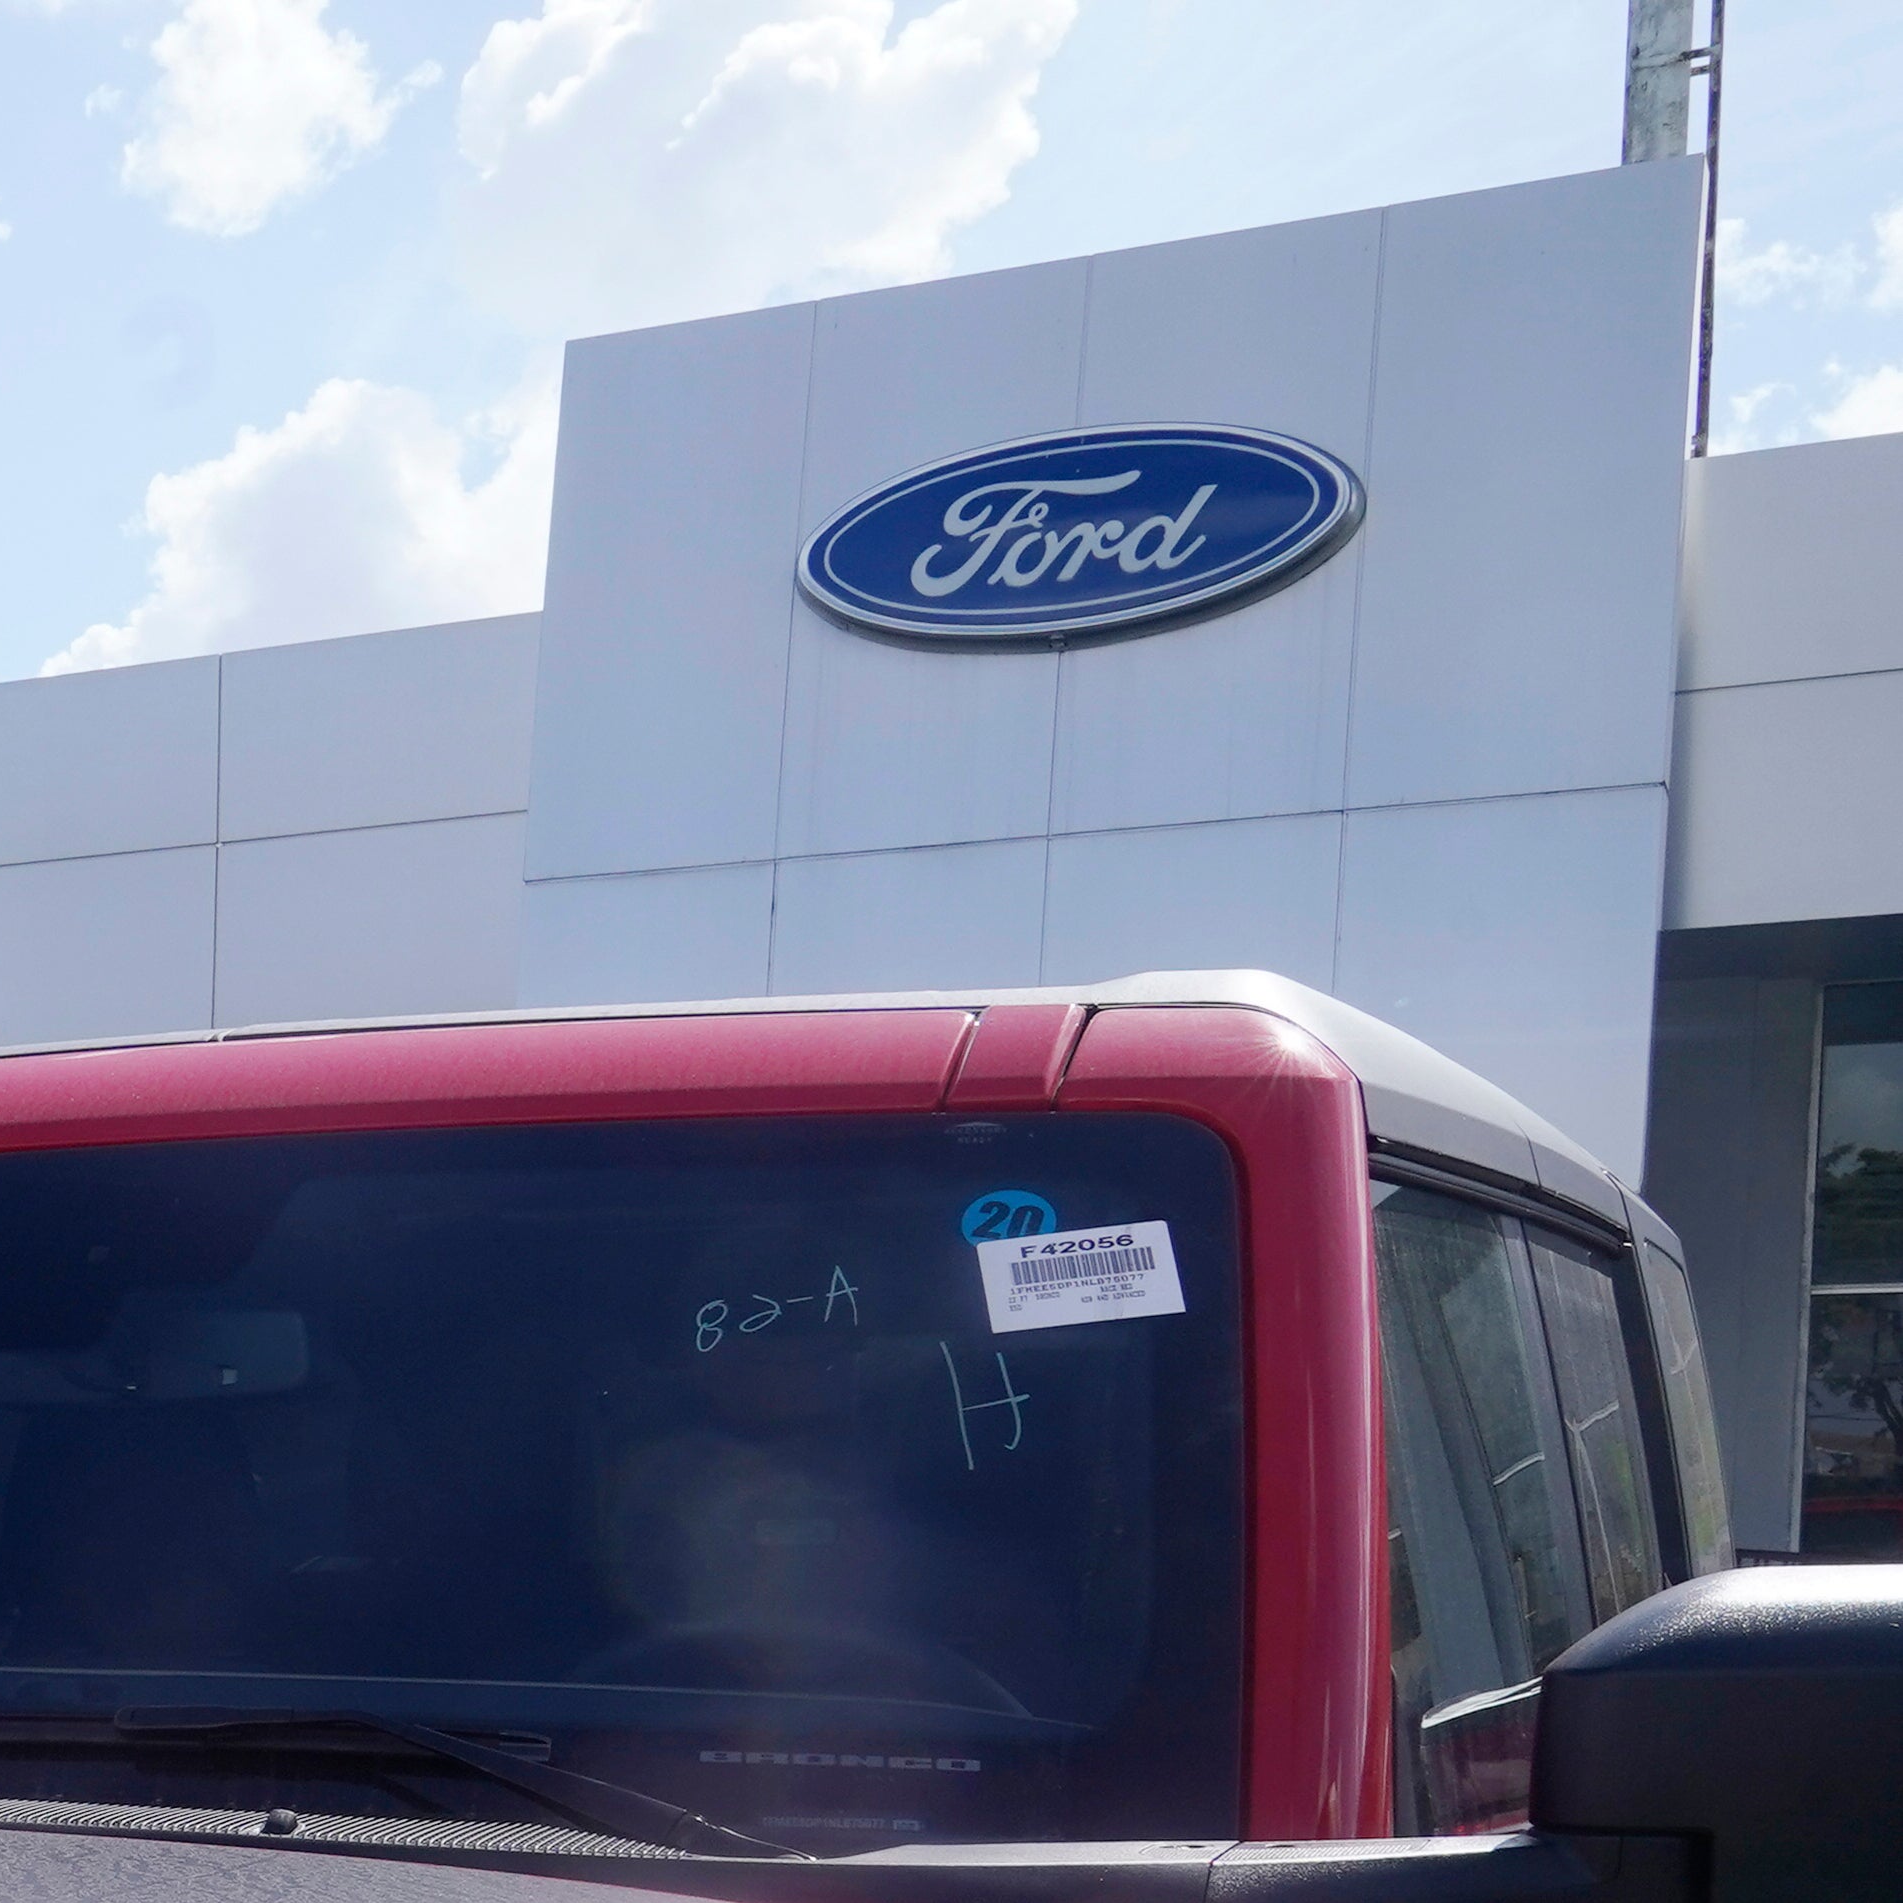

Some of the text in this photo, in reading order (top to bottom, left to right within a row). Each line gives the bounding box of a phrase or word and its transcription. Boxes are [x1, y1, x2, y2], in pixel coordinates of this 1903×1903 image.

[910, 469, 1217, 597] Ford
[1021, 1234, 1134, 1258] F42056
[699, 1751, 981, 1772] BRONCO
